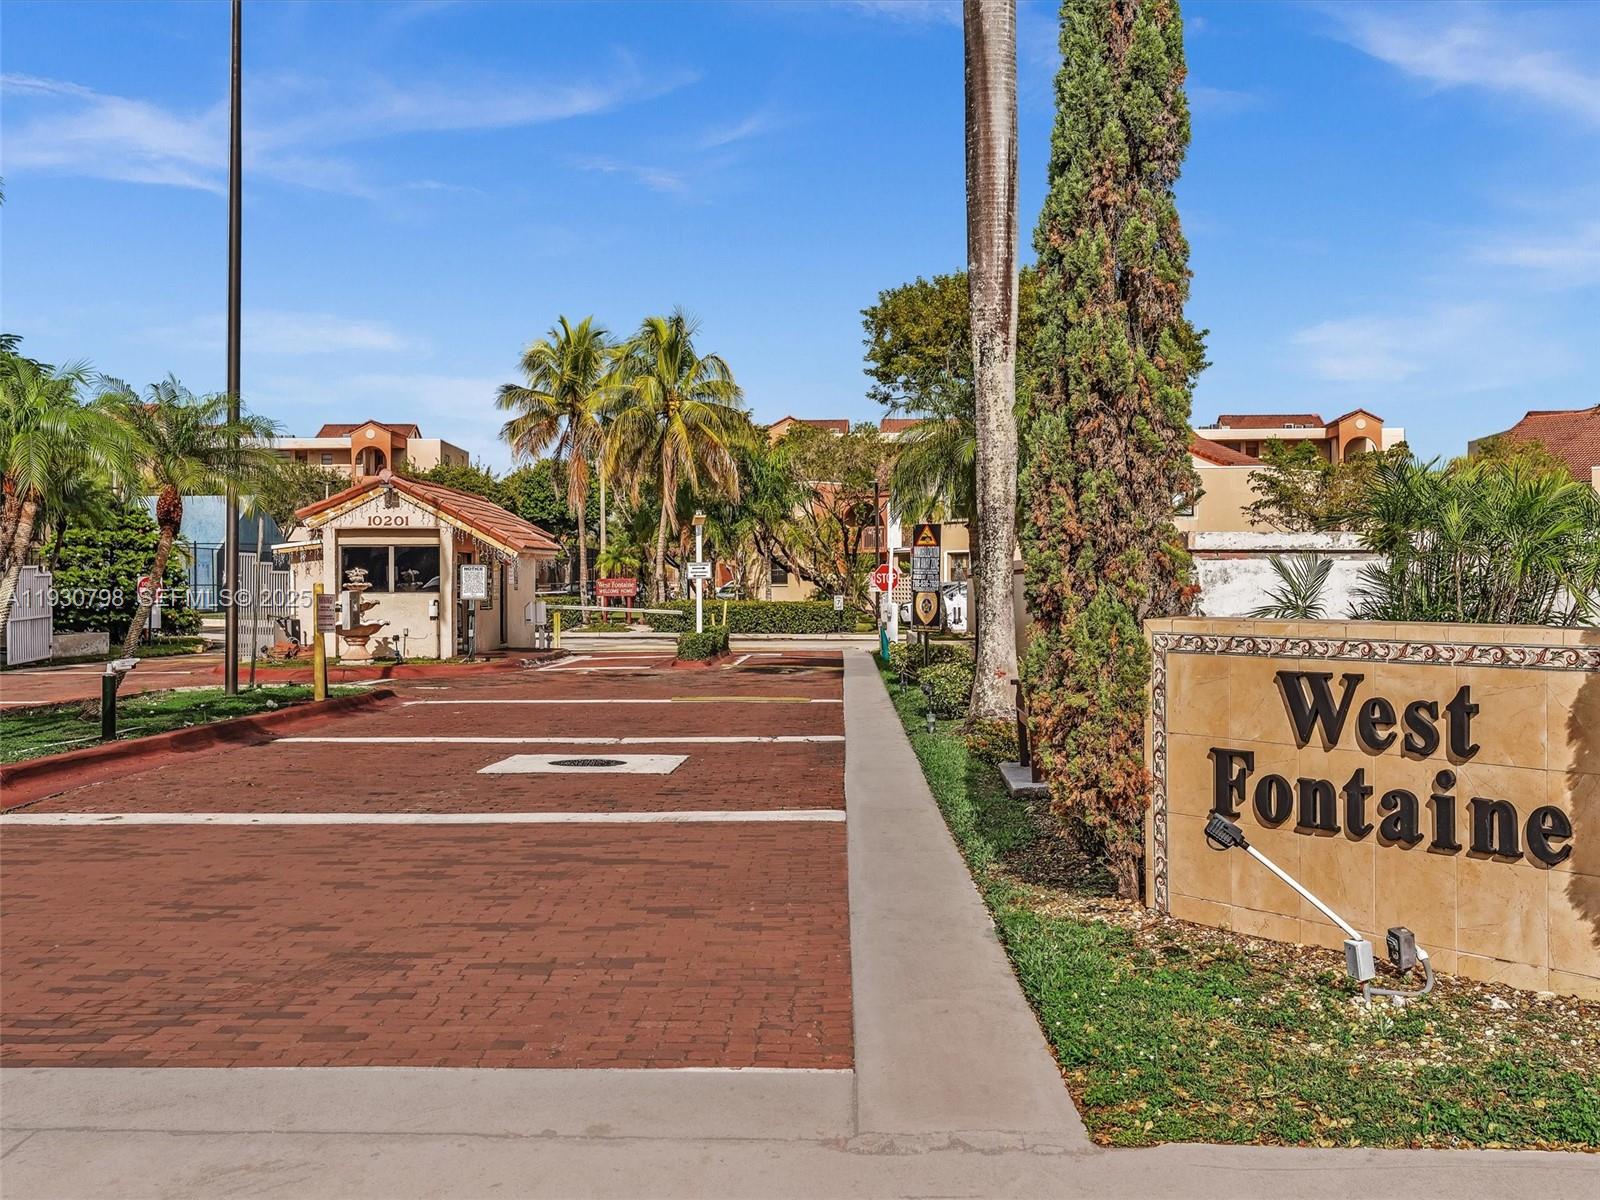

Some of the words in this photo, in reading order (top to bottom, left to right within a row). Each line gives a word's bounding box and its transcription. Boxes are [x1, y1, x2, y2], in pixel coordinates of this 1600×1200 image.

[367, 515, 409, 526] 10201
[876, 573, 897, 584] STOP
[1275, 670, 1480, 762] West
[1209, 747, 1573, 867] Fontaine
